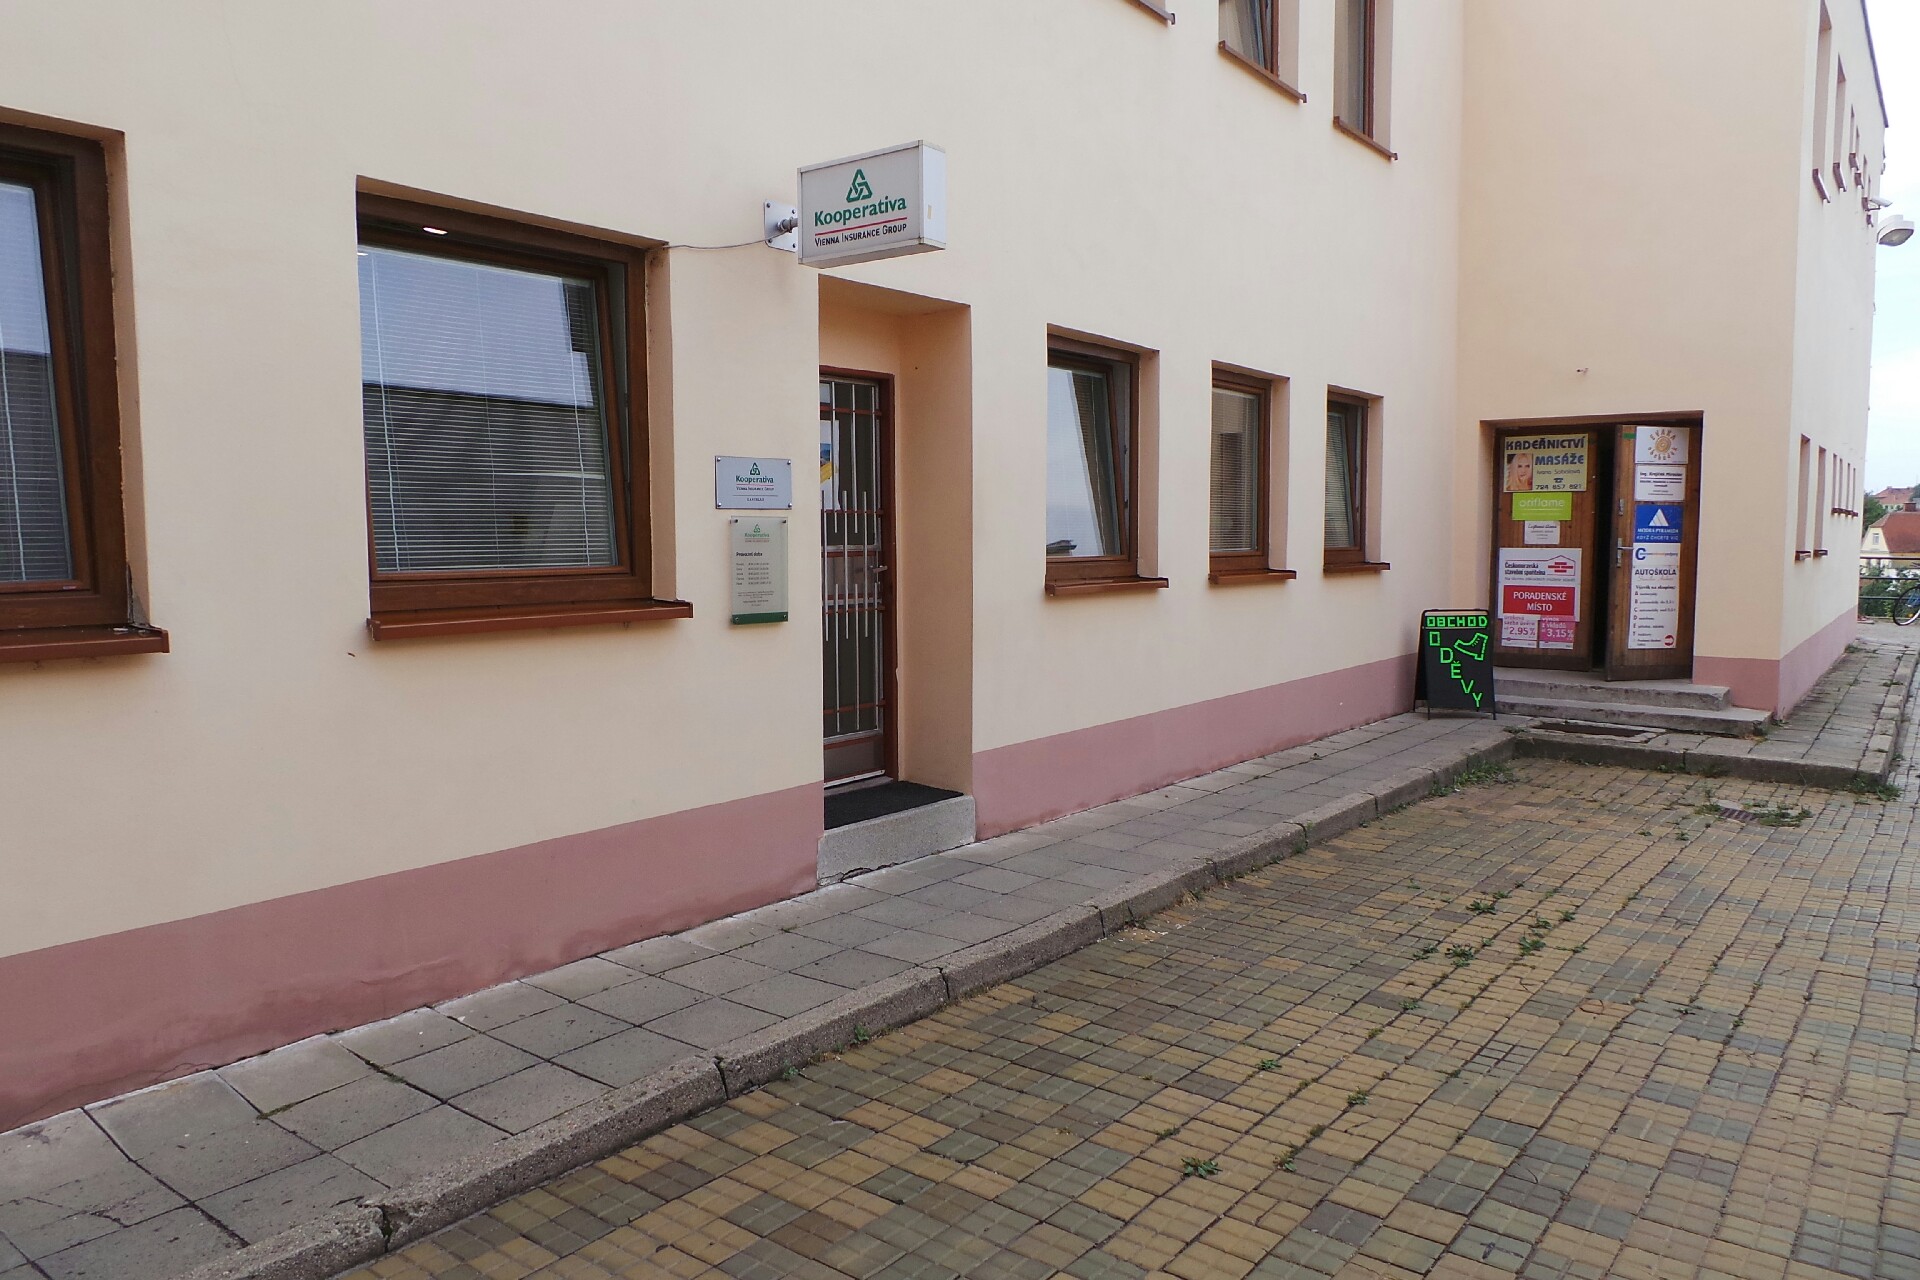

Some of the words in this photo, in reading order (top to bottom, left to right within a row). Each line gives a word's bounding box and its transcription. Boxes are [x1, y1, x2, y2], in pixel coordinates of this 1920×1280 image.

[814, 195, 907, 227] Kooperativa
[1506, 436, 1586, 451] KADEŘNICTVÍ
[1535, 453, 1584, 466] MASÁŽE
[736, 475, 774, 484] Kooperativa
[1519, 497, 1565, 507] oriflame
[1634, 567, 1677, 576] AUTOŠKOLA
[1513, 590, 1568, 601] PORADENSKÉ
[1526, 600, 1553, 612] MÍSTO
[1427, 616, 1488, 627] OBCHOD
[1429, 631, 1483, 708] ODĚVY
